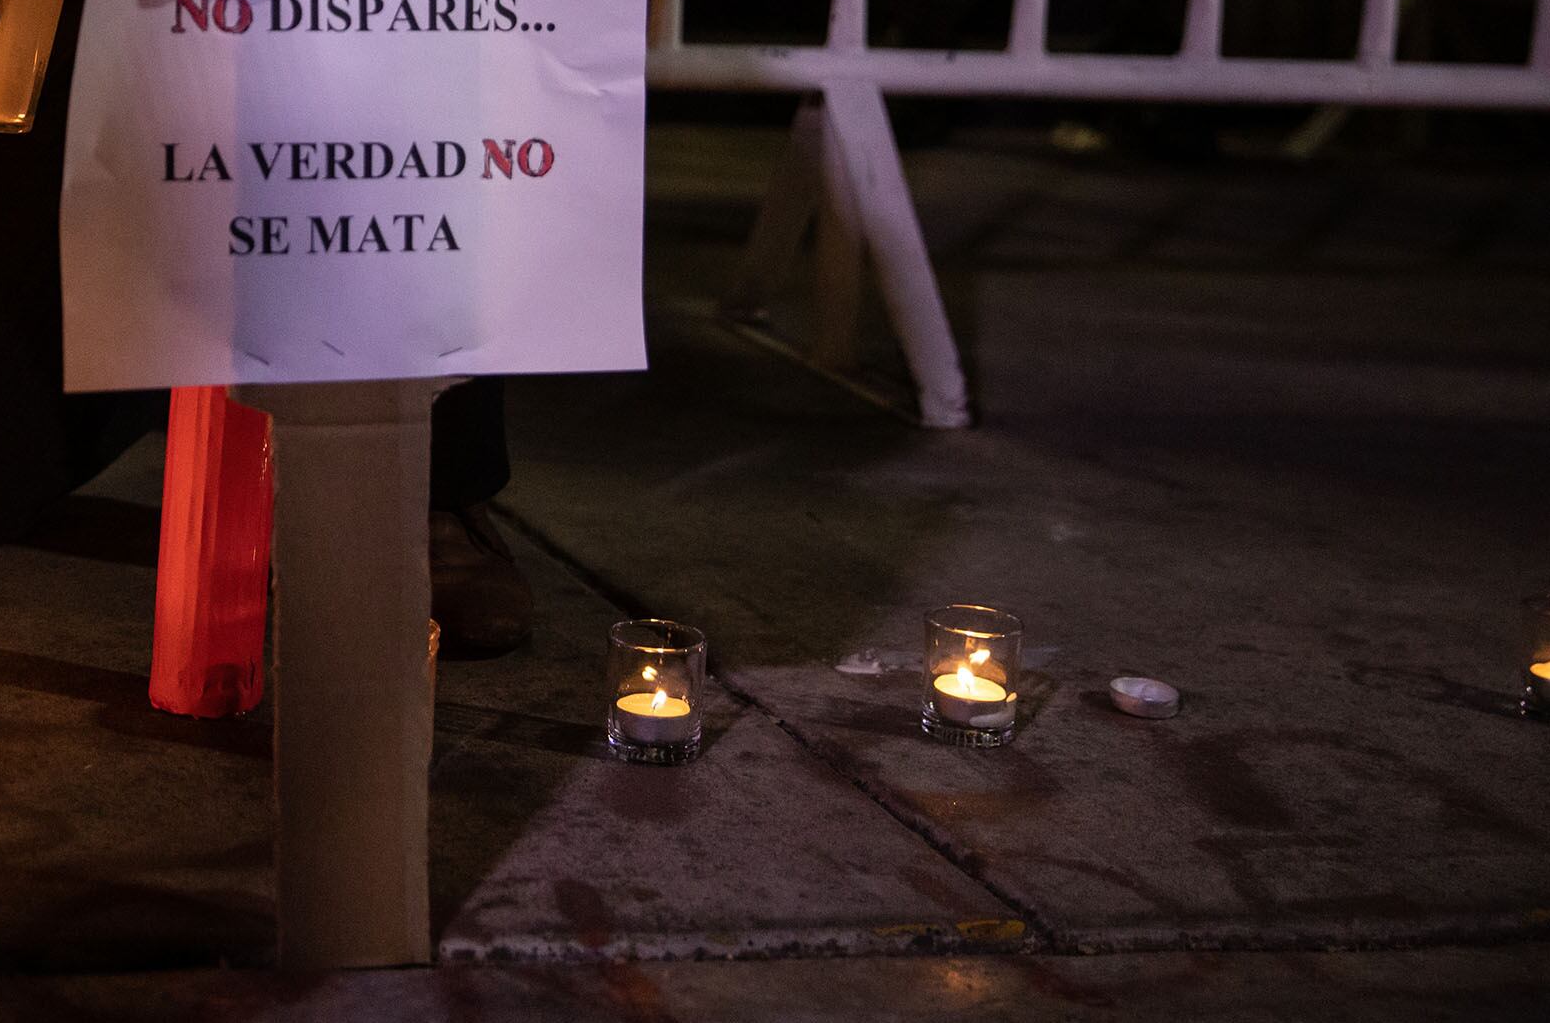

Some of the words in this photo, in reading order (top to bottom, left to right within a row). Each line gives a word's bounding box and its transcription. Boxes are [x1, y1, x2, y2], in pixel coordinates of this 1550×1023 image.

[161, 142, 234, 182] LA
[250, 140, 467, 181] VERDAD
[481, 138, 555, 180] NO
[229, 215, 290, 256] SE
[307, 214, 462, 255] MATA
